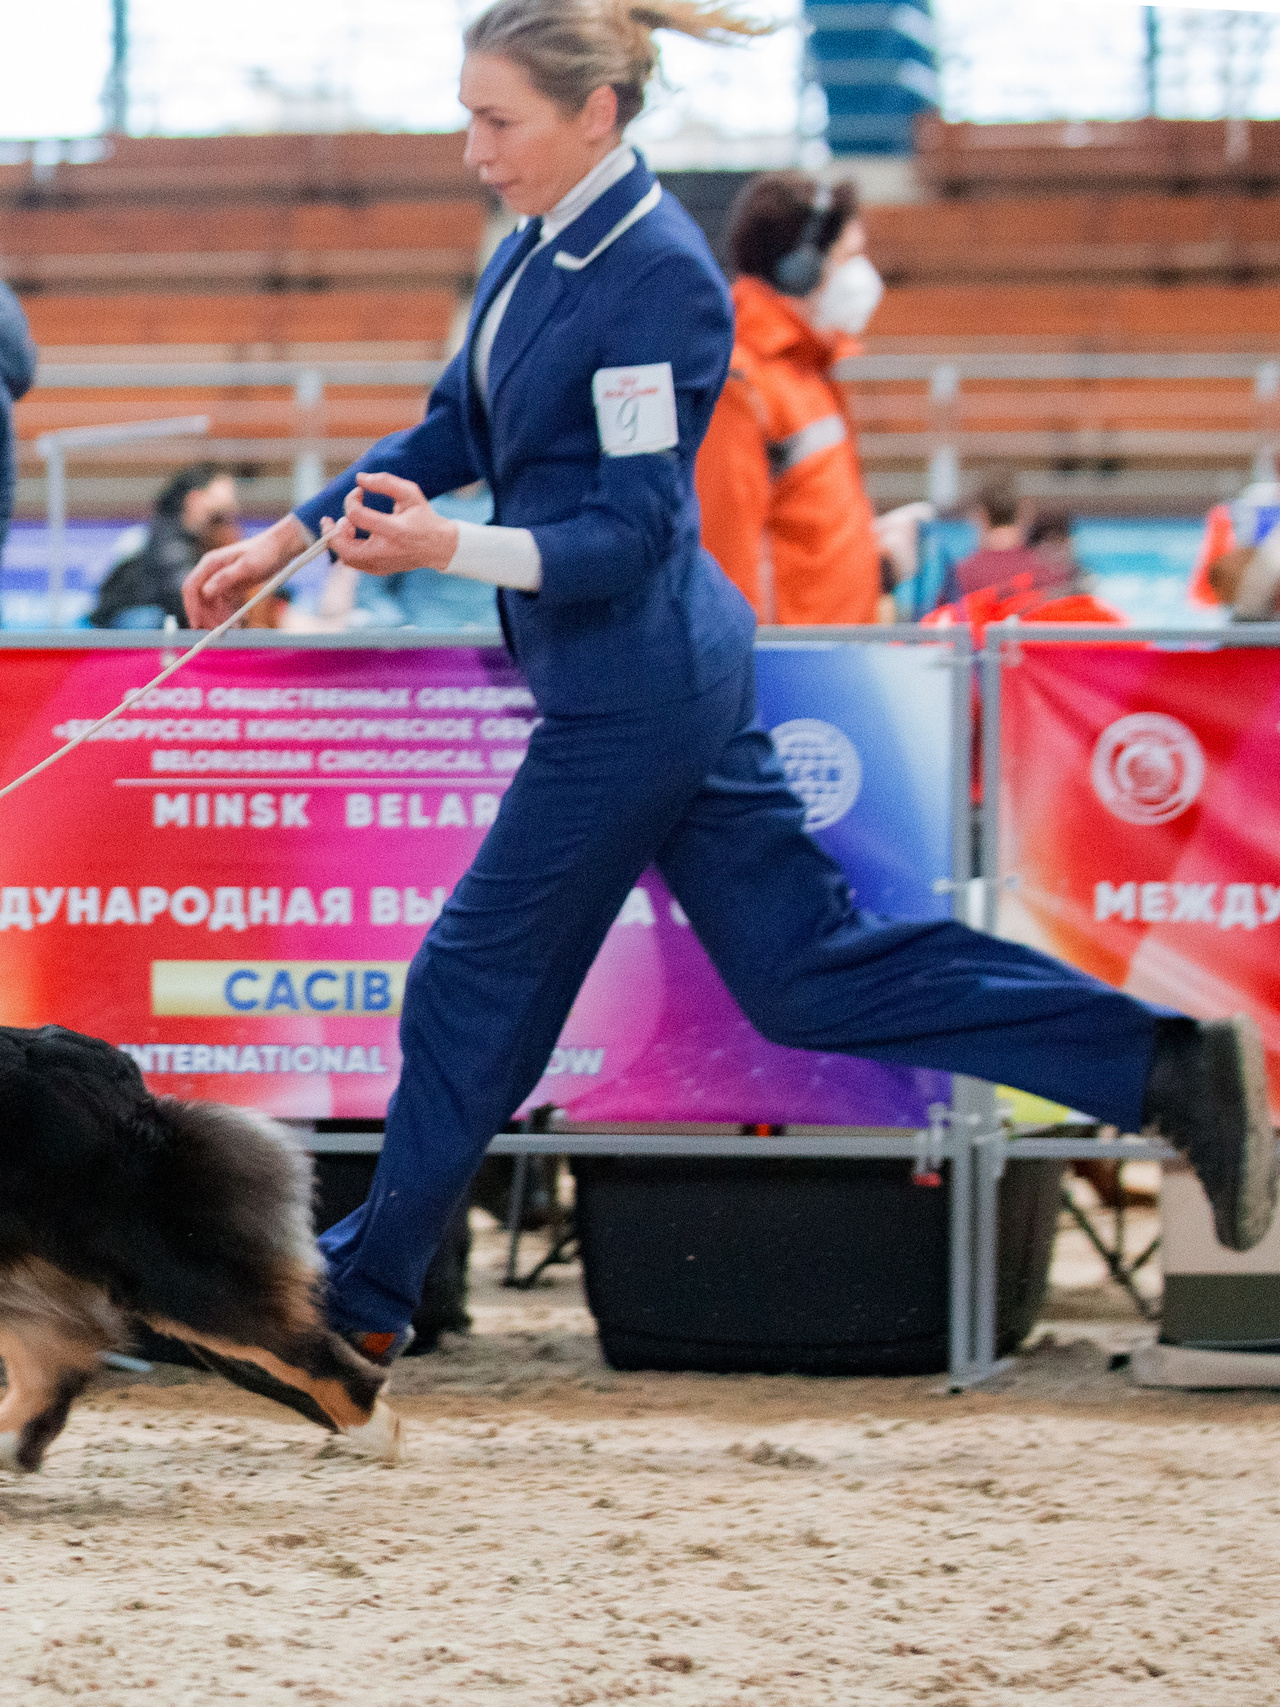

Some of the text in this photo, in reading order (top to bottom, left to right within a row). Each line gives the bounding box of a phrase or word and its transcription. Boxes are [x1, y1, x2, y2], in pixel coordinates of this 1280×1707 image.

[153, 794, 500, 827] MINSK BELAR
[223, 970, 393, 1012] CACIB
[545, 1047, 606, 1075] OW
